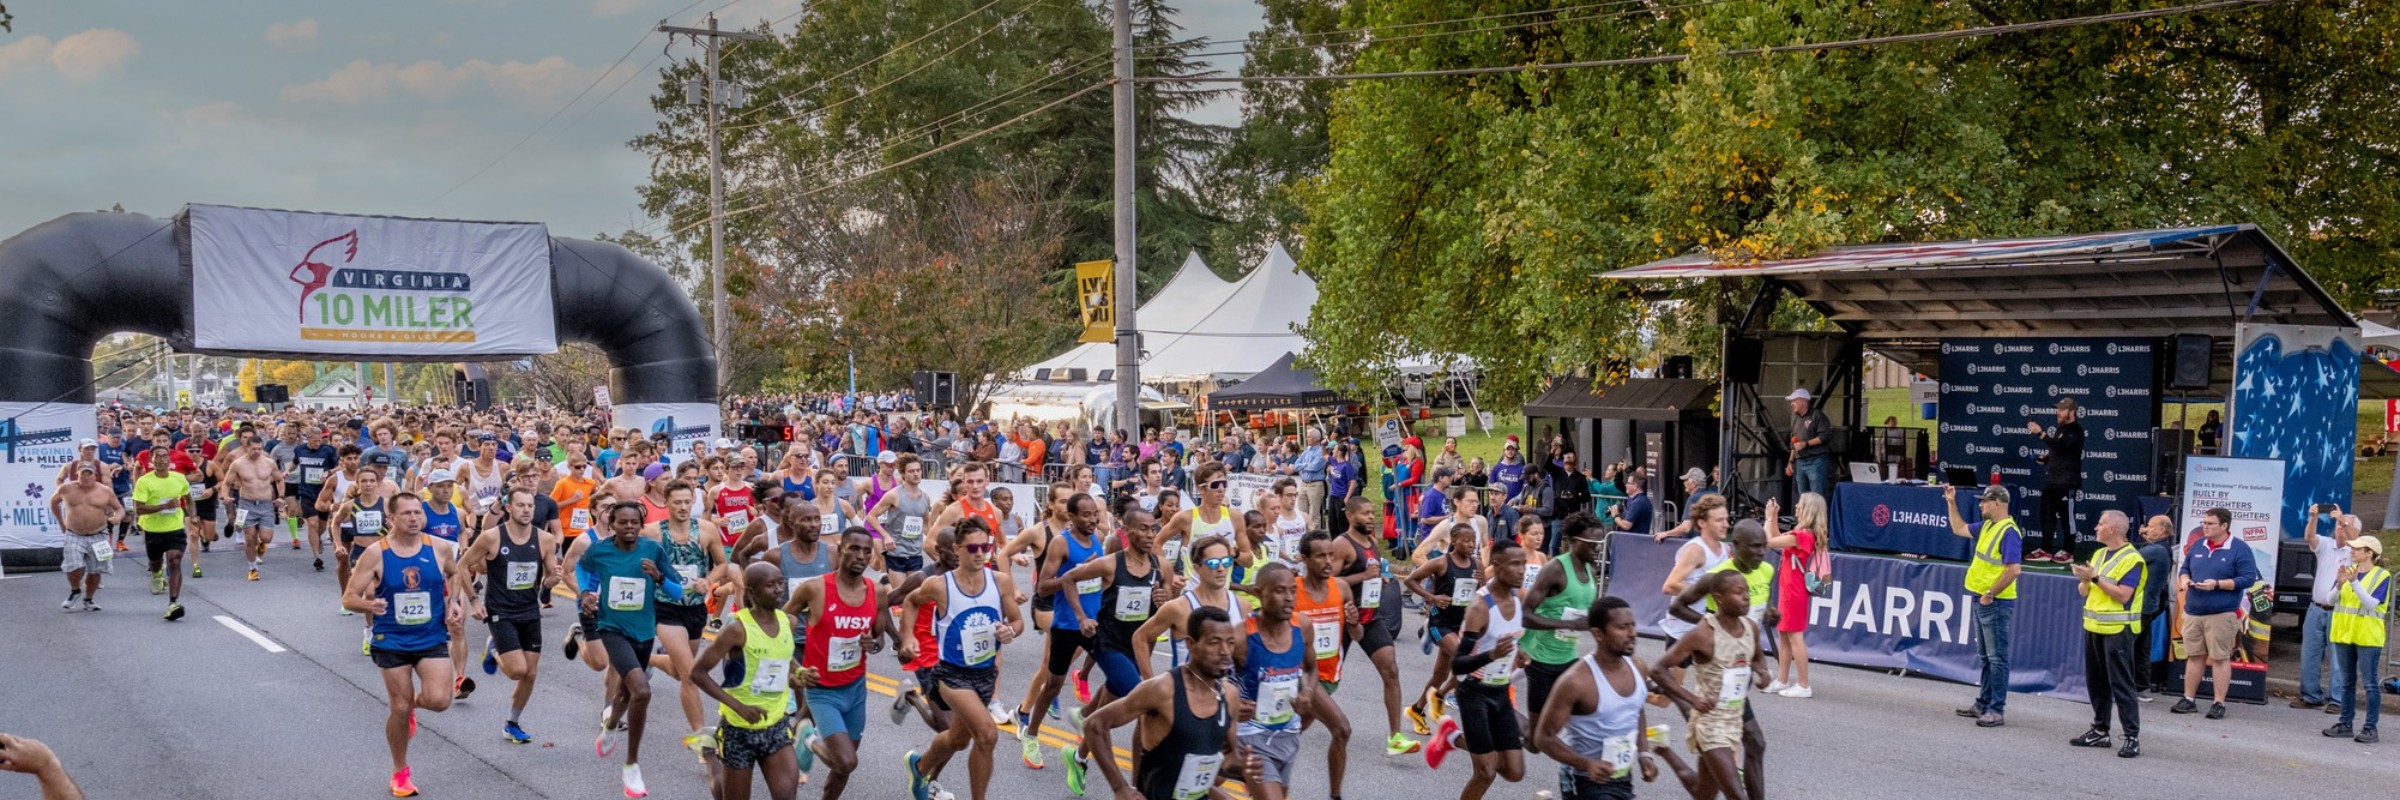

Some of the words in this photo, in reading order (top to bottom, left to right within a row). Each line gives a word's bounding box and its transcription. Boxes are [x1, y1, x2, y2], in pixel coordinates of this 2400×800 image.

[344, 272, 463, 288] VIRGINIA
[314, 292, 353, 325] 10
[363, 294, 475, 328] MILER
[1951, 385, 1979, 393] L3HARRIS
[2003, 386, 2033, 394] L3HARRIS
[2059, 387, 2090, 395] L3HARRIS
[2117, 388, 2149, 396] L3HARRIS
[2030, 407, 2059, 415] L3HARRI
[2087, 408, 2119, 416] L3HARRIS
[2086, 451, 2118, 459] L3HARRIS
[2002, 467, 2031, 475] L3HARRIS
[2115, 473, 2147, 481] L3HARRIS
[2085, 493, 2117, 501] L3HARRIS
[2192, 490, 2216, 498] BUILT
[2192, 500, 2252, 509] FIREFIGHTERS
[13, 508, 45, 525] MILE
[1892, 510, 1948, 528] L3HARRIS
[358, 519, 381, 527] 2003
[730, 518, 745, 528] 950
[515, 572, 528, 581] 28
[620, 591, 634, 601] 14
[402, 605, 424, 615] 422
[1126, 600, 1141, 611] 42
[834, 616, 872, 630] WSX
[974, 640, 989, 652] 30
[1318, 636, 1331, 648] 13
[841, 650, 855, 661] 12
[768, 675, 776, 686] 7
[1195, 772, 1211, 786] 15
